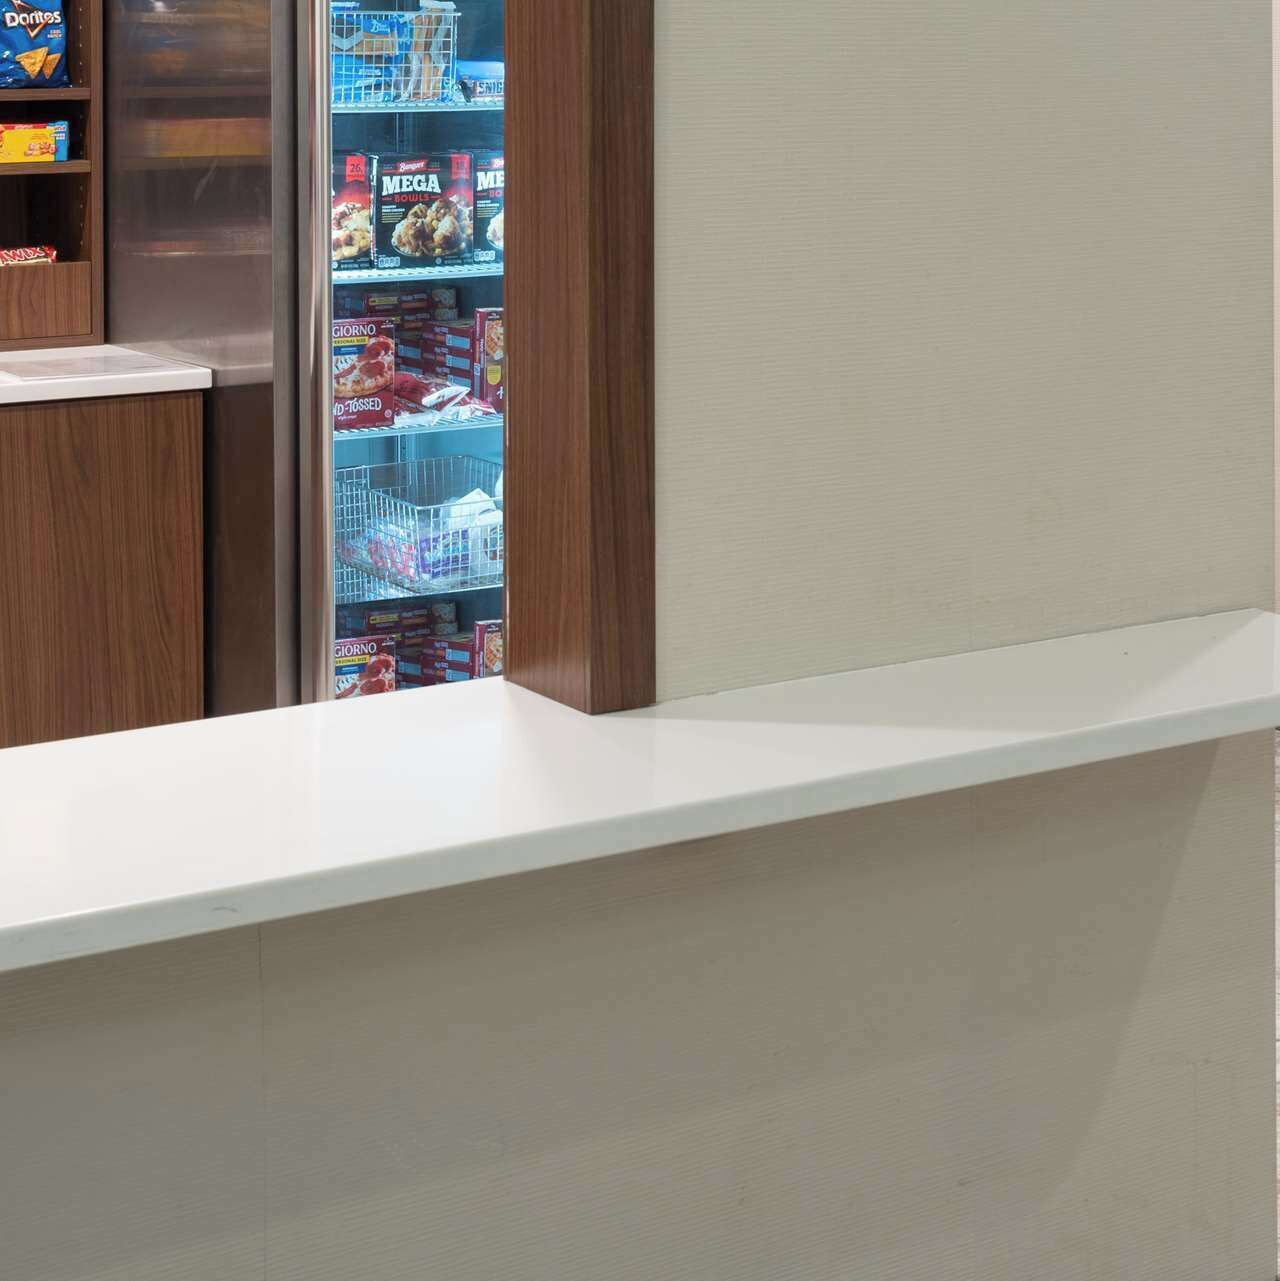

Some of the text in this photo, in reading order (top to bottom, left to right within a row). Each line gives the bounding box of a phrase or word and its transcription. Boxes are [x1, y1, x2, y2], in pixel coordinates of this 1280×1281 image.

[5, 10, 62, 27] Doritos
[382, 174, 441, 196] MEGA
[394, 194, 429, 202] BOWLS
